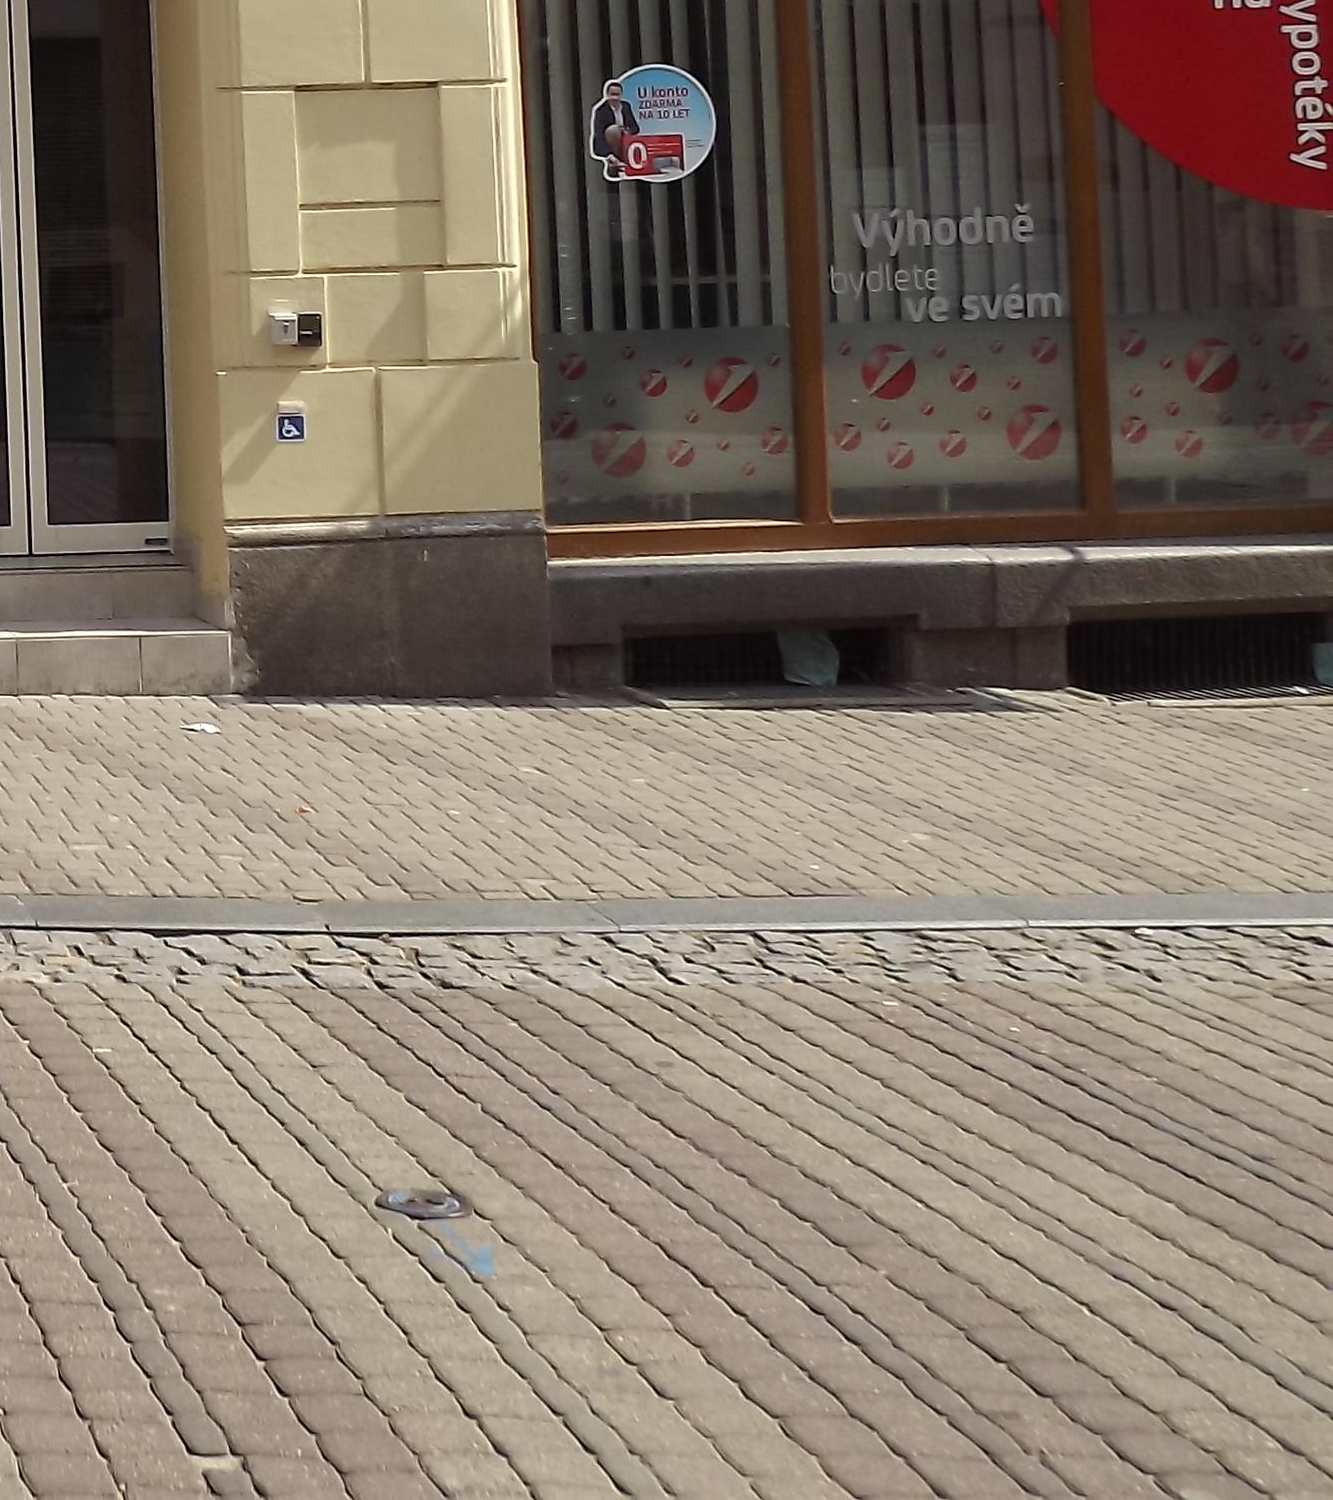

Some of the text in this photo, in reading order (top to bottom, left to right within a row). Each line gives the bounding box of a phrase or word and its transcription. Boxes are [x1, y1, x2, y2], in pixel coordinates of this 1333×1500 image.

[637, 85, 689, 99] U konto
[638, 99, 683, 109] ZDARMA
[638, 109, 691, 120] NA 10 LET
[627, 141, 648, 170] 0
[852, 202, 1034, 258] Výhodně
[828, 261, 942, 300] bydlete
[903, 281, 1064, 324] ve svém
